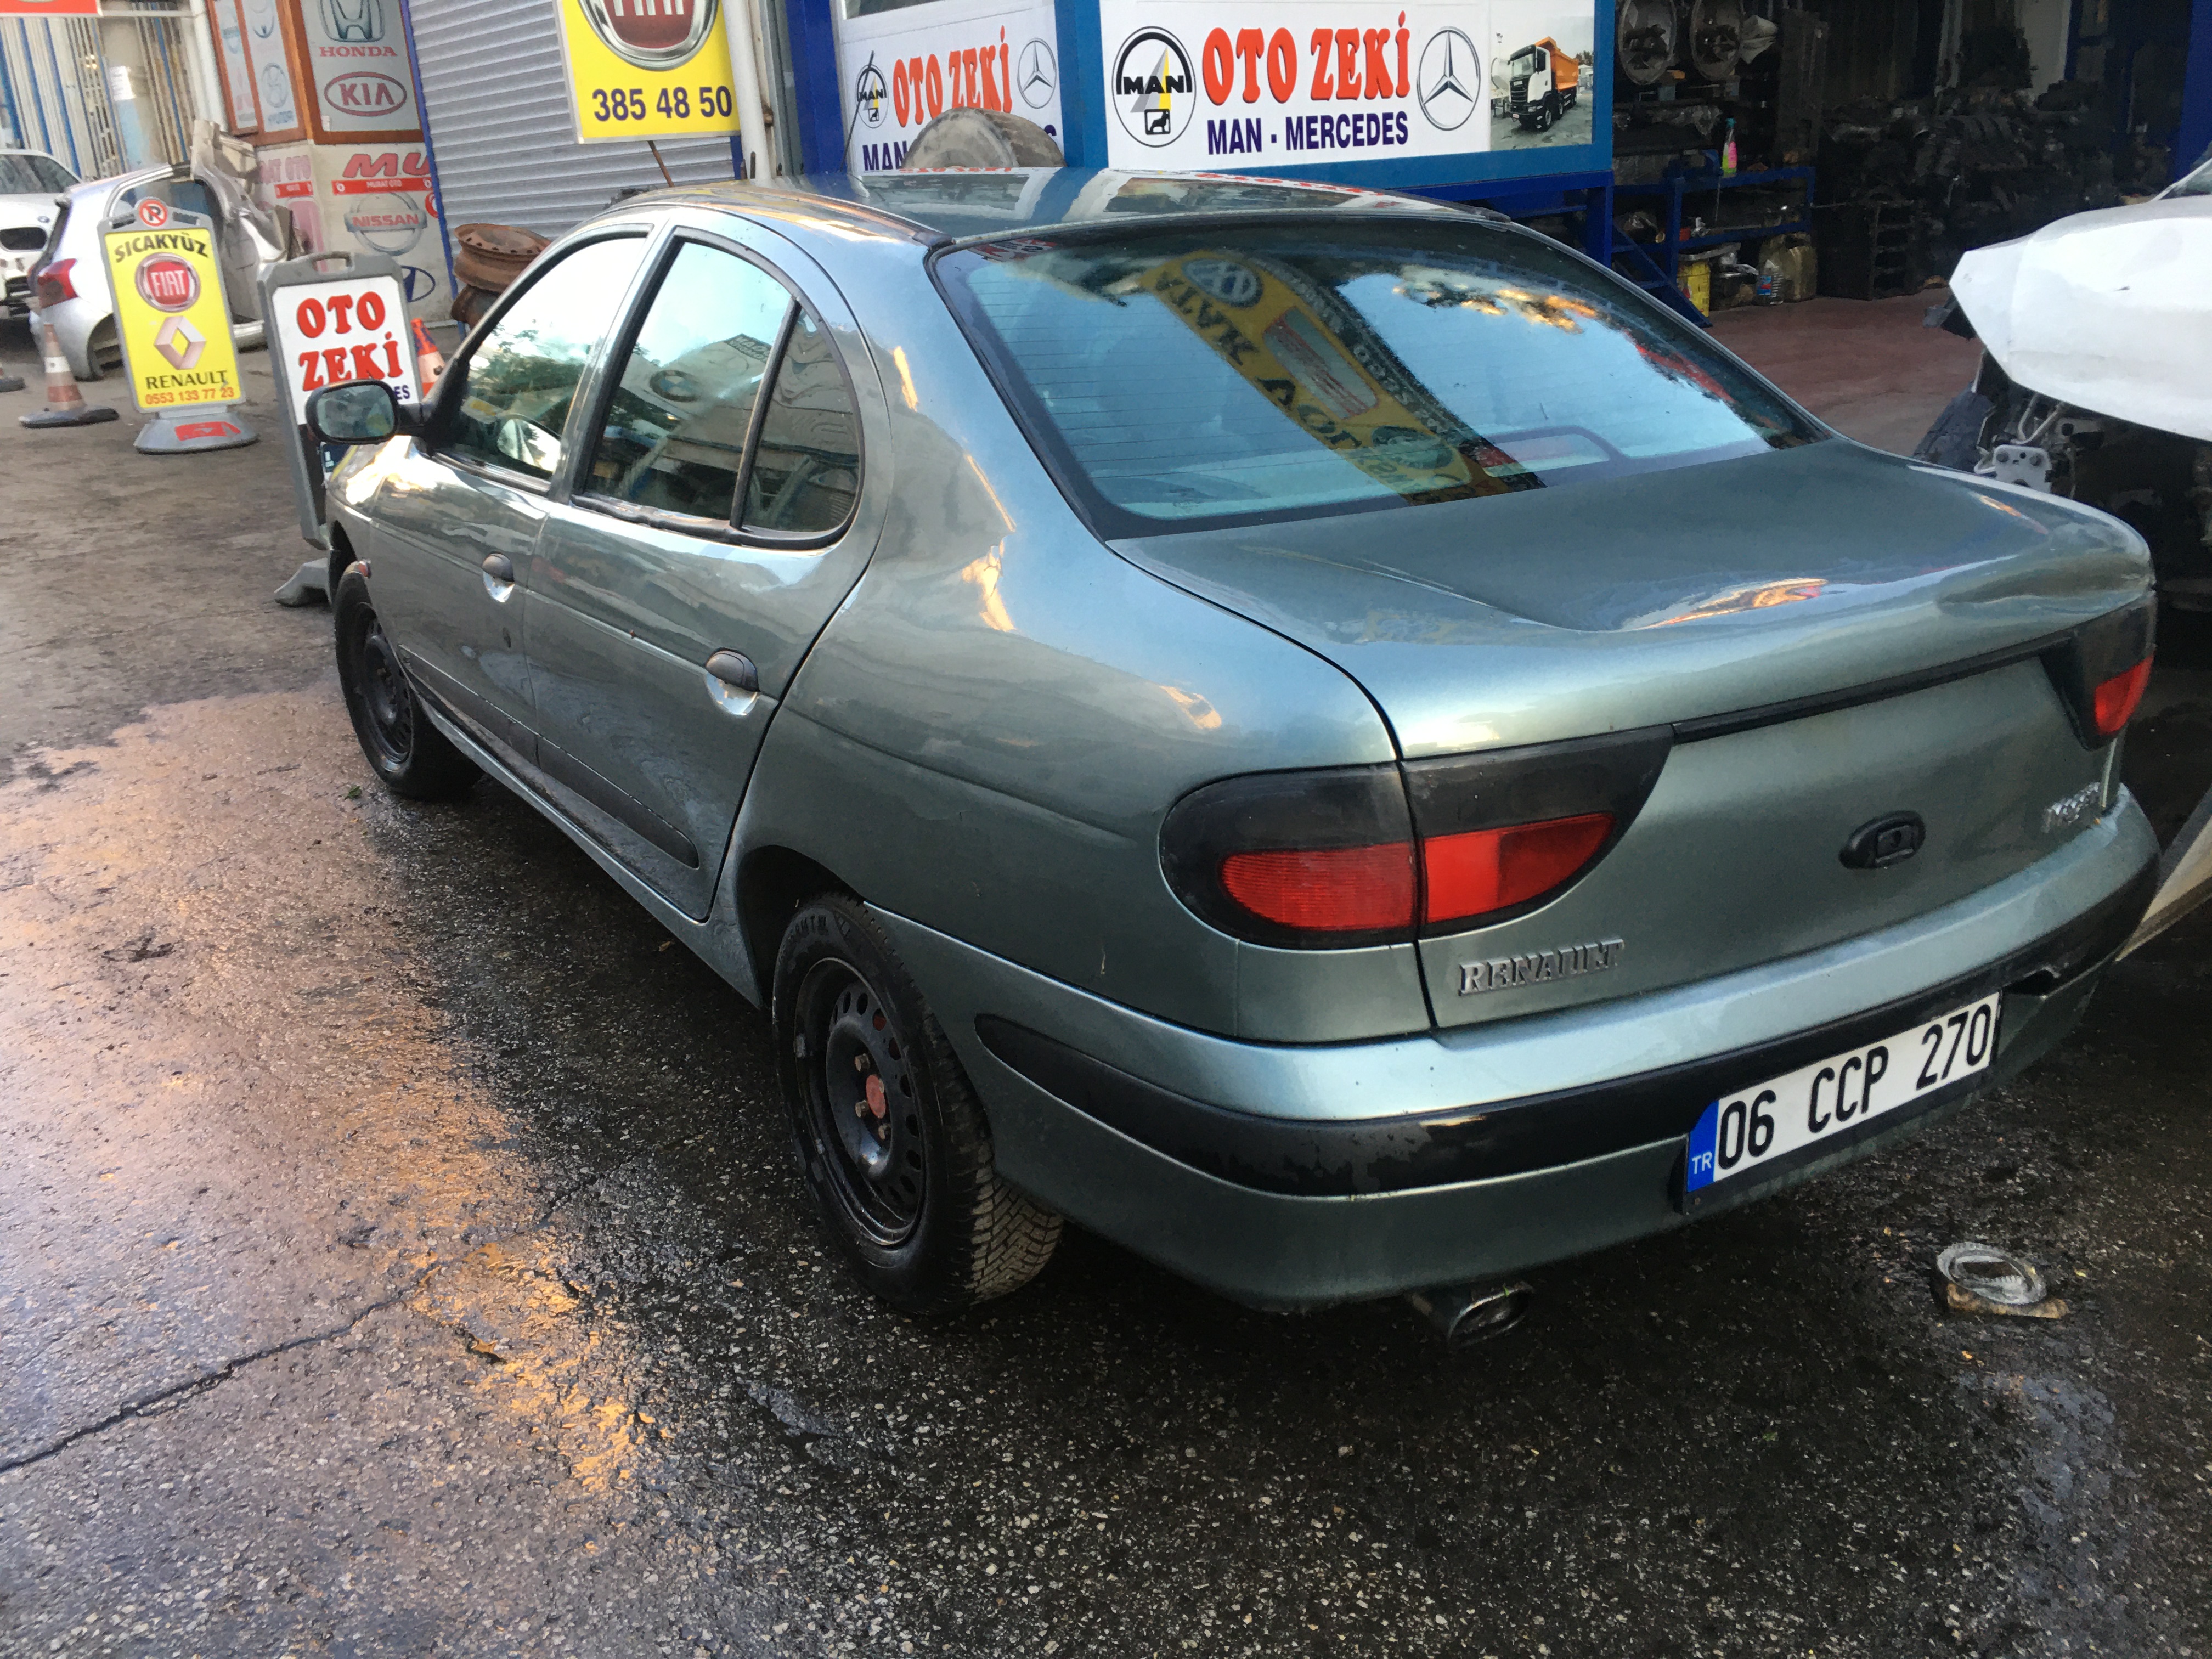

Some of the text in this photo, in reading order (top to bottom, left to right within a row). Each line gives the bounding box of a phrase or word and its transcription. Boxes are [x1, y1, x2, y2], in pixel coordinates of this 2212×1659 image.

[319, 46, 397, 57] HONDA
[1201, 10, 1412, 106] OTO ZEKİ
[893, 25, 1013, 128] OTO ZEKİ
[1123, 75, 1184, 95] MAN
[338, 83, 395, 106] KIA
[592, 85, 732, 122] 385 48 50
[1207, 118, 1262, 155] MAN
[1285, 111, 1409, 151] MERCEDES
[352, 213, 419, 227] NISSAN
[150, 269, 186, 297] FIAT
[297, 291, 386, 338] OTO
[298, 331, 403, 391] ZEKİ
[145, 370, 227, 390] RENAULT
[145, 392, 175, 405] 0553
[202, 388, 216, 399] 77
[221, 387, 235, 398] 23
[1458, 939, 1624, 996] RENAULT
[1718, 1003, 1991, 1170] 06 CCP 270
[1691, 1151, 1713, 1175] TR
